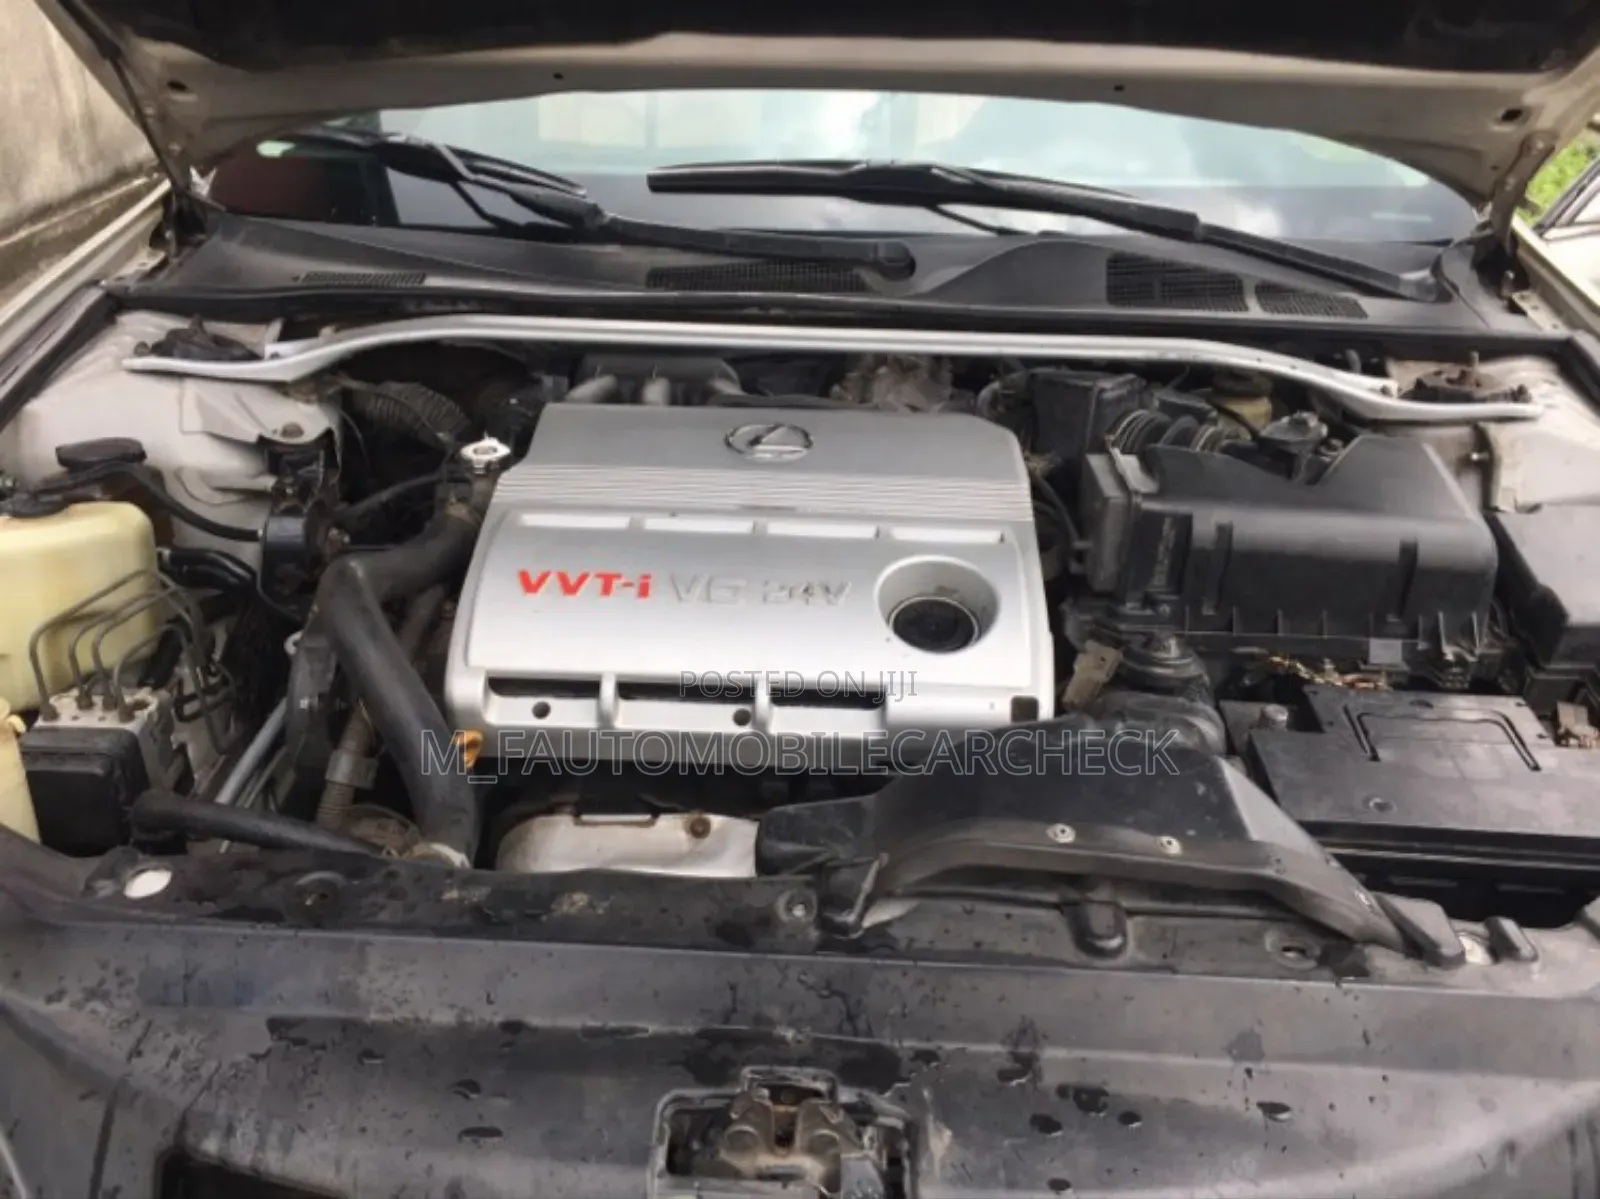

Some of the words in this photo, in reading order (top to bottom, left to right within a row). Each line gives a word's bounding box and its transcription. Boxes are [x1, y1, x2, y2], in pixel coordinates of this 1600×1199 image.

[517, 569, 652, 599] VVT-i
[670, 572, 748, 605] V6
[761, 578, 853, 606] 24V
